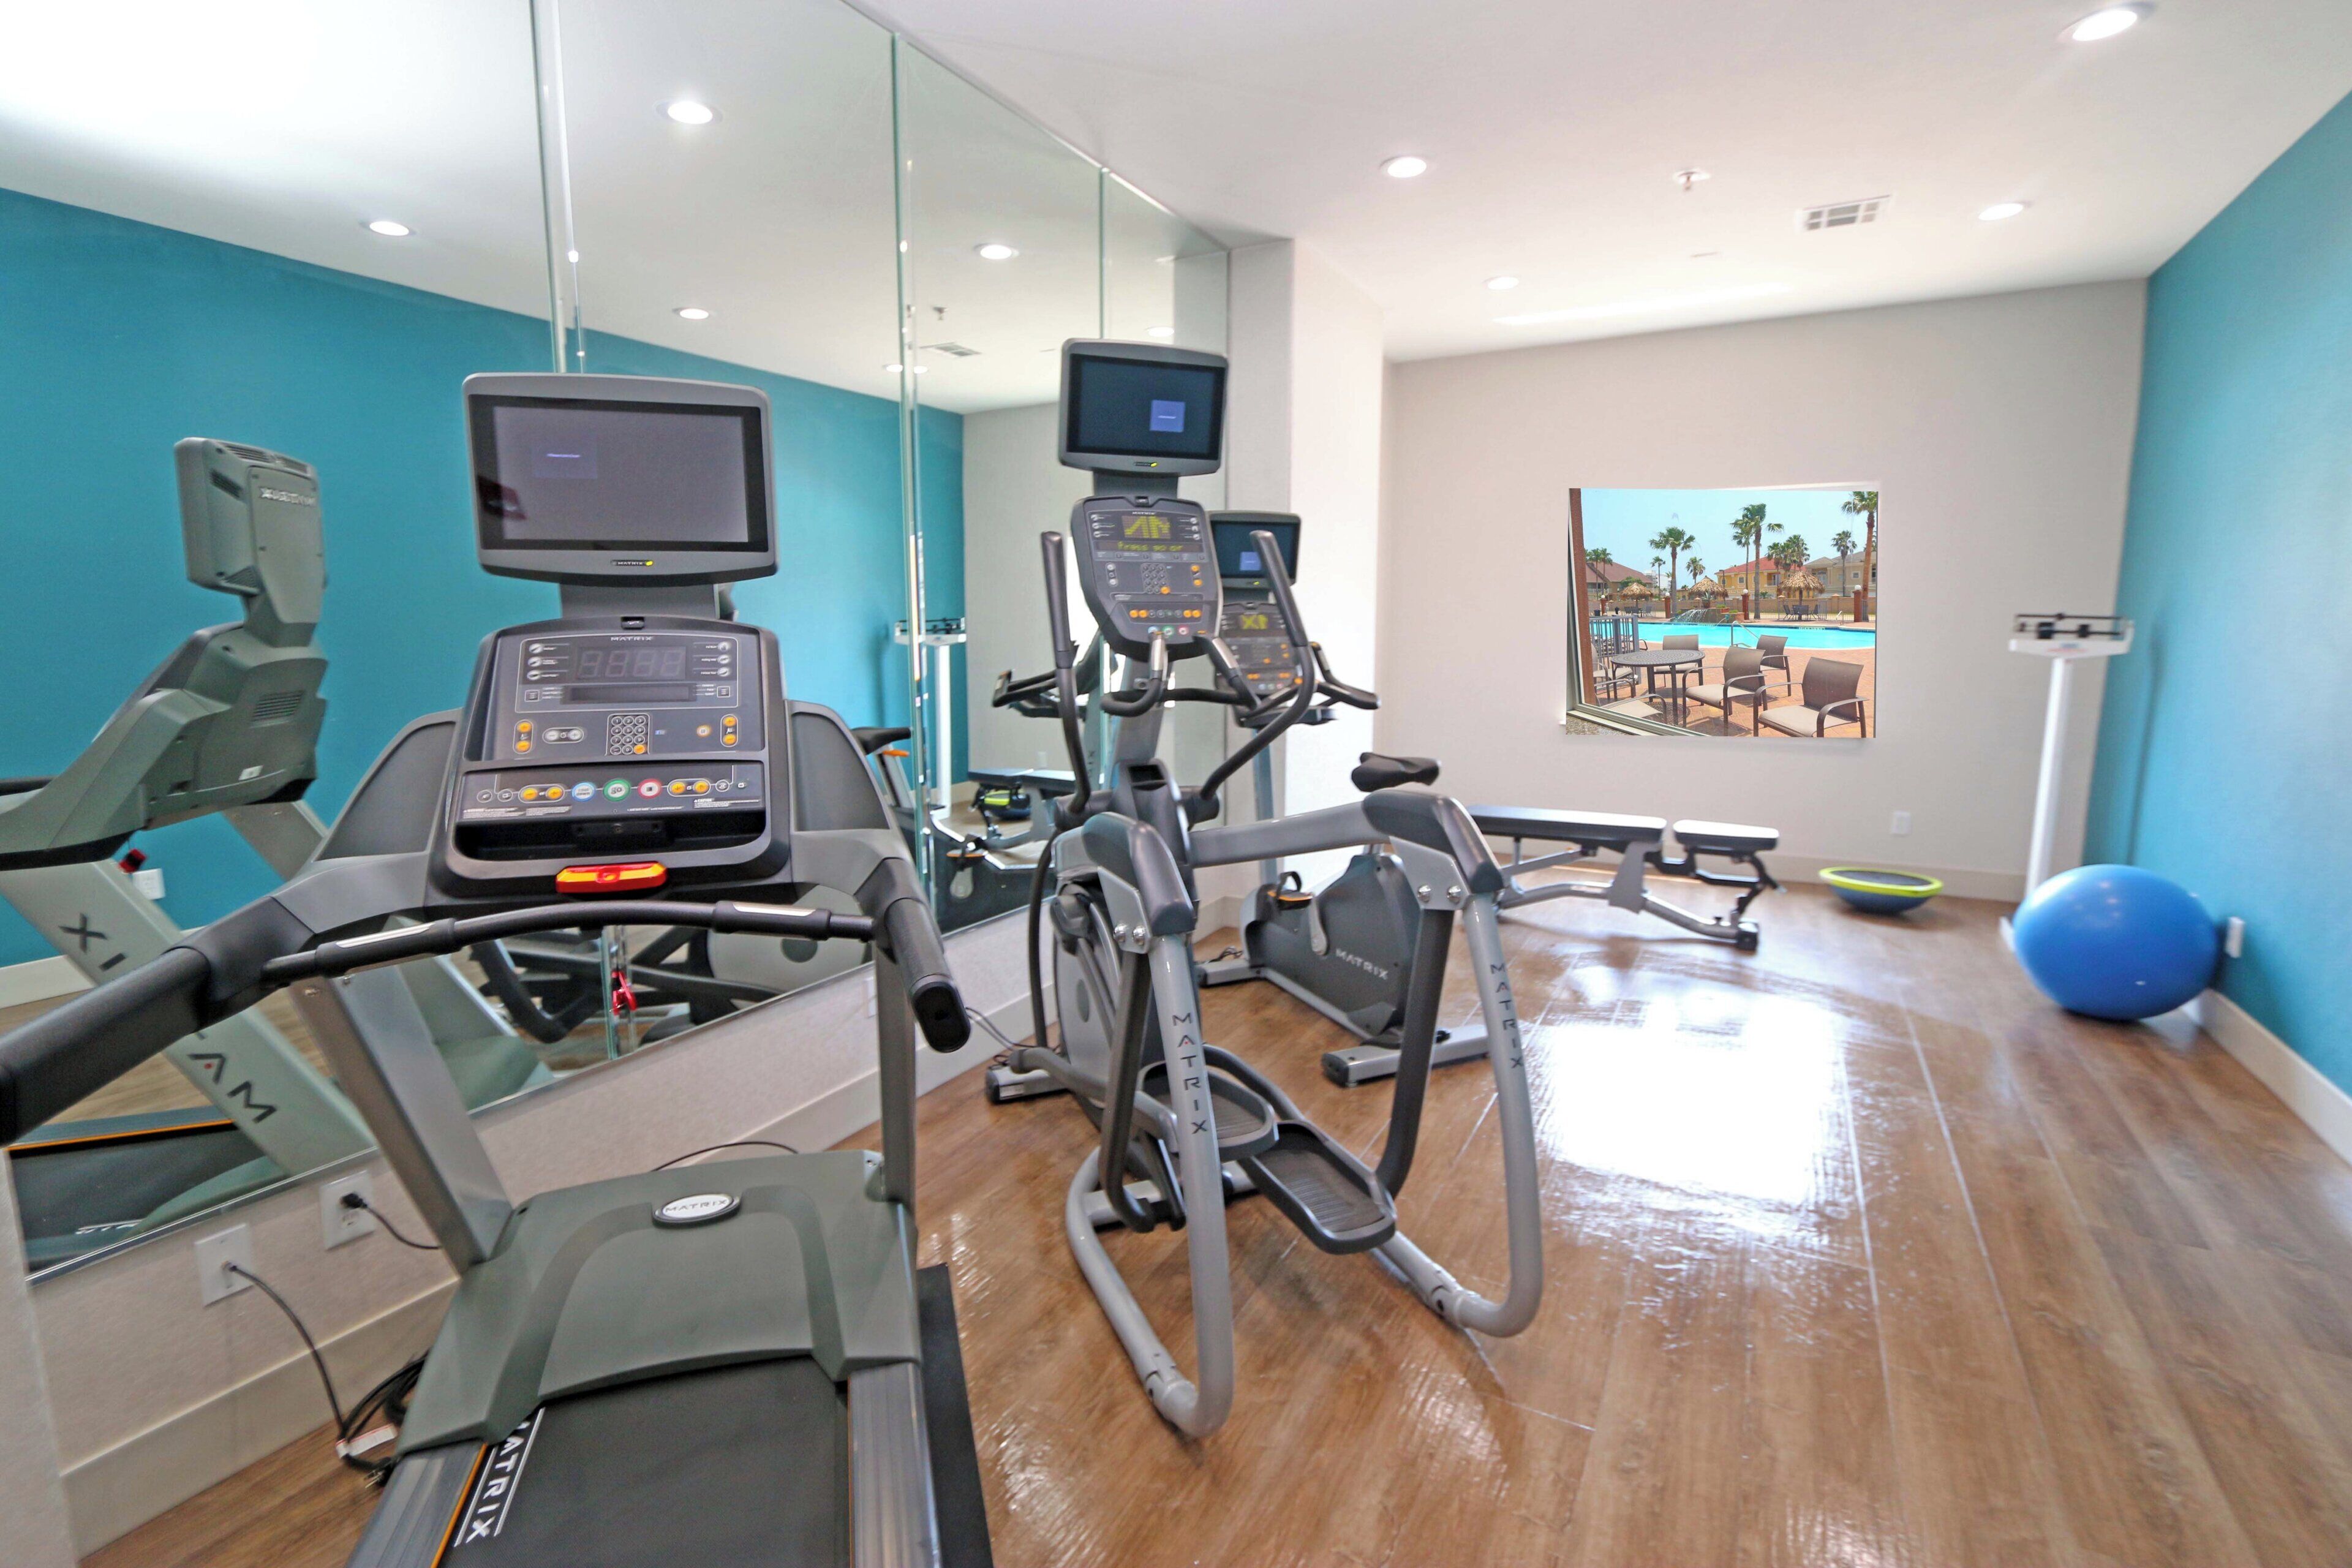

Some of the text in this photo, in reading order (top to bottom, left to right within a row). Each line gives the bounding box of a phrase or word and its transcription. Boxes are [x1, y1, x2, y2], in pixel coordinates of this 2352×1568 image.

[1336, 948, 1388, 980] MATRIX
[1490, 963, 1524, 1069] MATRIX
[1172, 1012, 1208, 1134] MATRIX
[665, 1199, 728, 1212] MATRIX
